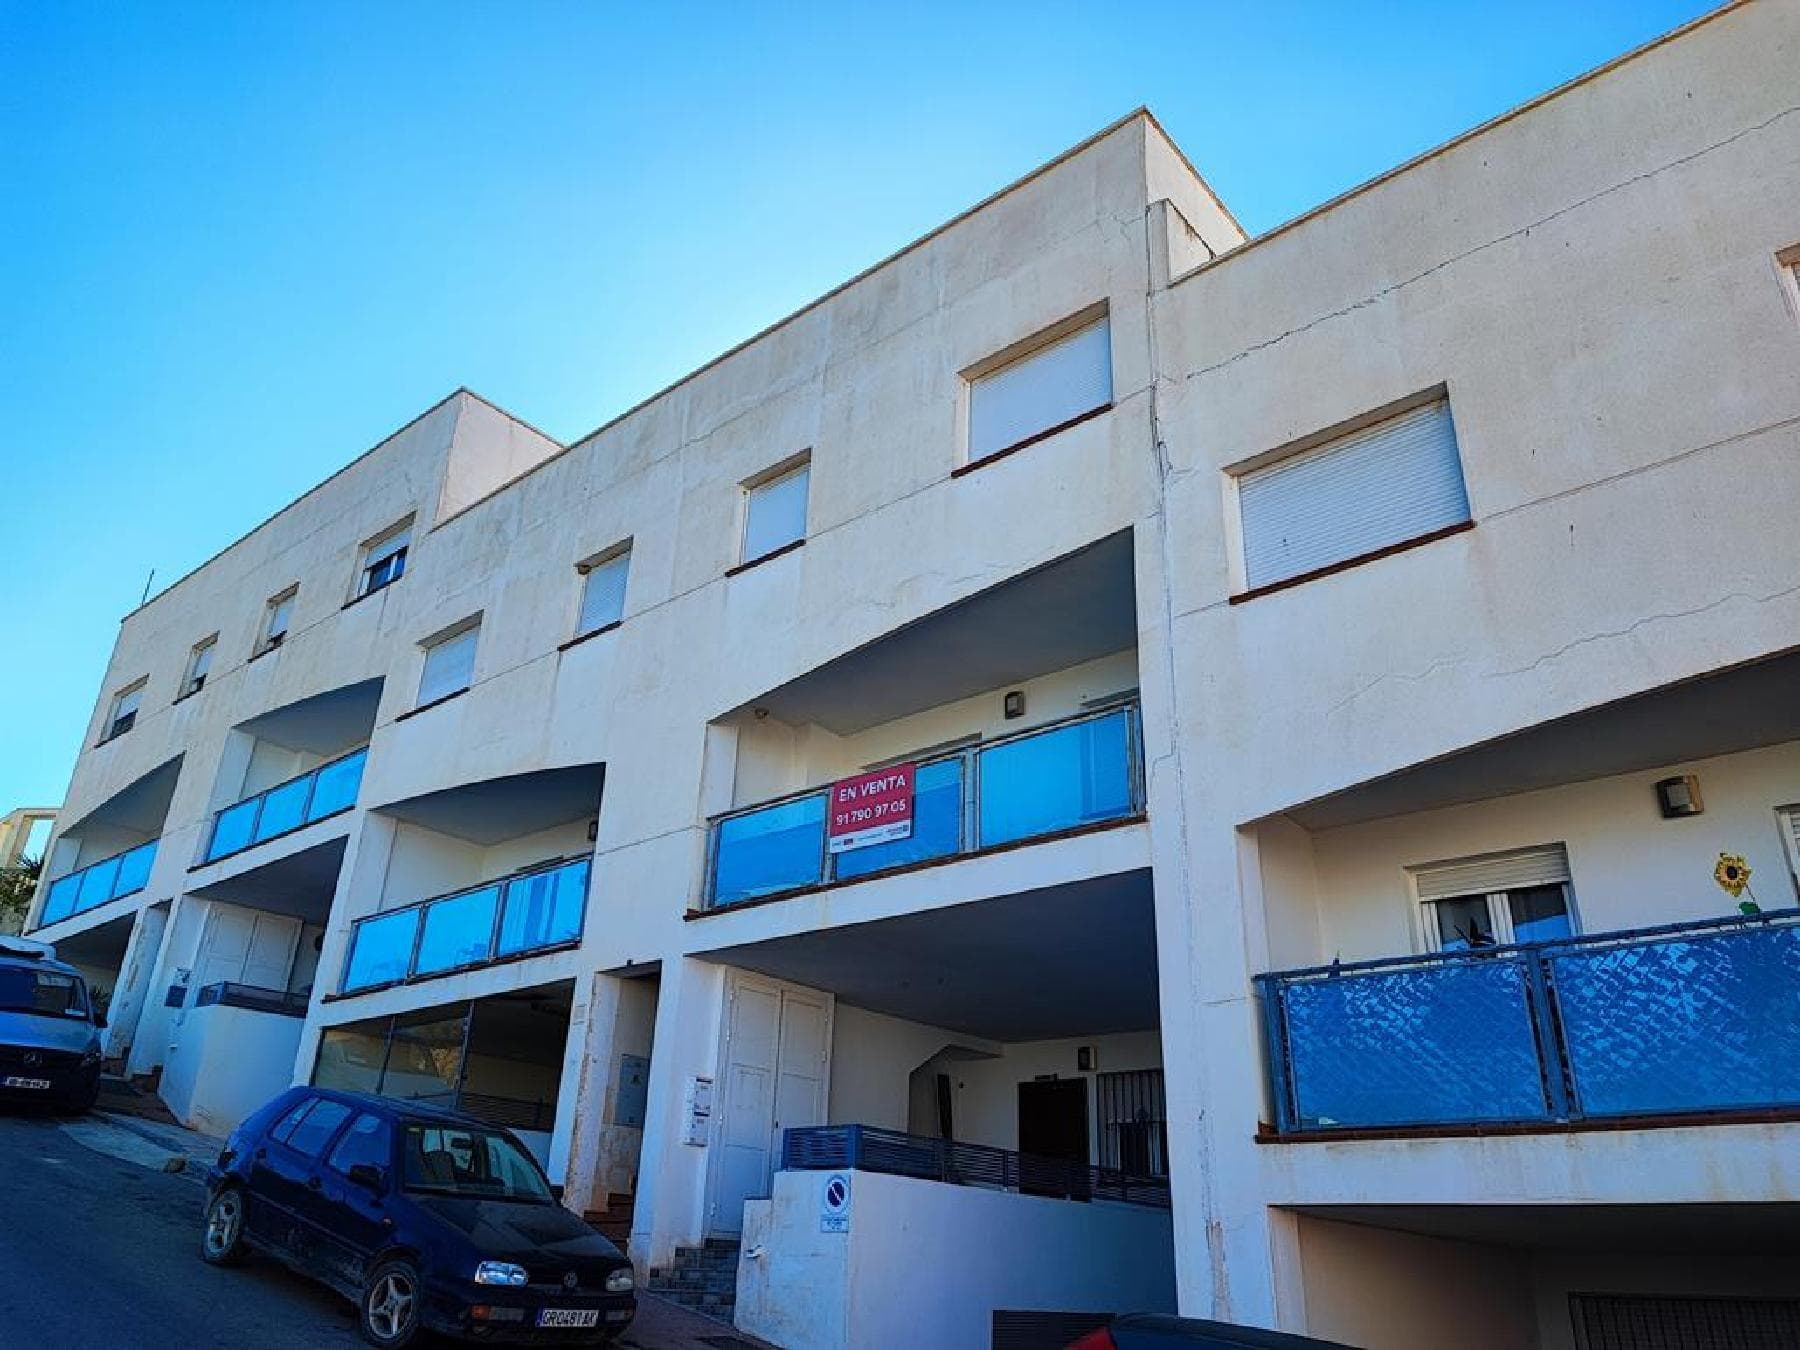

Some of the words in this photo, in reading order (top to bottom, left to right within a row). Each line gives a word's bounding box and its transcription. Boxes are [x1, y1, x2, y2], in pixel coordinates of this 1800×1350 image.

[839, 786, 857, 802] EN
[861, 775, 906, 797] VENTA
[875, 803, 889, 818] 97
[890, 799, 906, 812] 05
